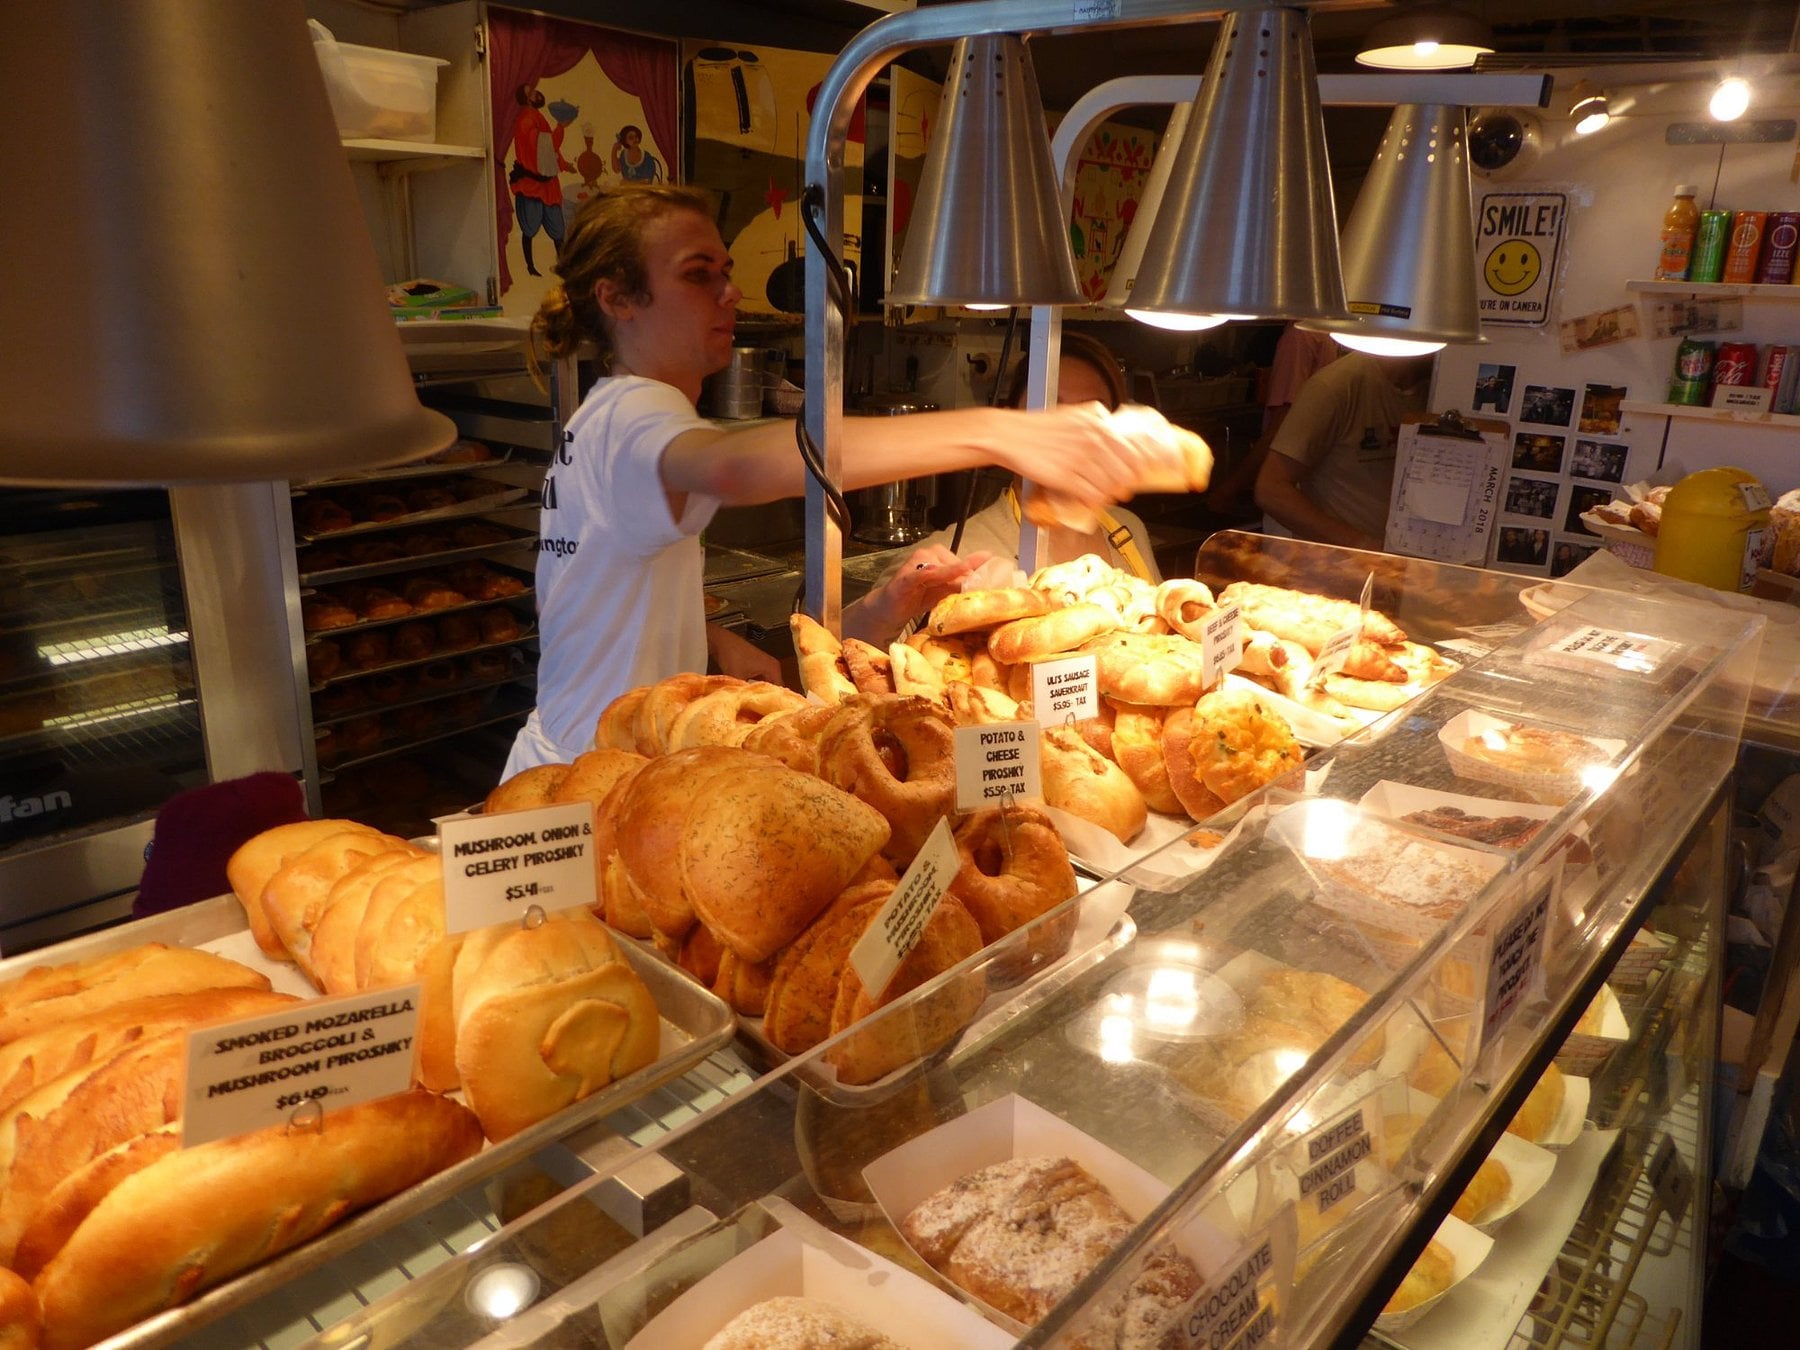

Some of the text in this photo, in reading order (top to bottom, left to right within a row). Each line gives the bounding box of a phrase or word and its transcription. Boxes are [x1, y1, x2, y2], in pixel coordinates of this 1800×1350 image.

[1484, 205, 1558, 236] SMILE!
[1480, 299, 1542, 312] U'RE ON CAMERA
[1475, 466, 1499, 534] MARCH 2018
[1050, 683, 1088, 698] SAUERKRAUT
[1064, 669, 1090, 682] SAUSAGE
[1076, 696, 1087, 706] TAX
[980, 730, 1025, 745] POTATO &
[986, 748, 1020, 762] CHEESE
[982, 765, 1025, 781] PIROSHKY
[1009, 782, 1026, 795] TAX
[0, 790, 73, 823] fan
[541, 824, 580, 842] ONION
[582, 822, 593, 836] &
[465, 843, 585, 877] CELERY PIROSHKY
[884, 873, 922, 930] POTATO
[214, 1024, 300, 1055] SMOKED
[258, 1027, 376, 1065] BROCCOLI &
[207, 1036, 413, 1099] MUSHROOM PIROSHKY
[1310, 1113, 1362, 1159] COFFEE
[1300, 1135, 1371, 1194] CINNAMON
[1319, 1173, 1356, 1206] ROLL
[1188, 1242, 1271, 1337] CHOCOLATE
[1210, 1289, 1257, 1350] CREAM
